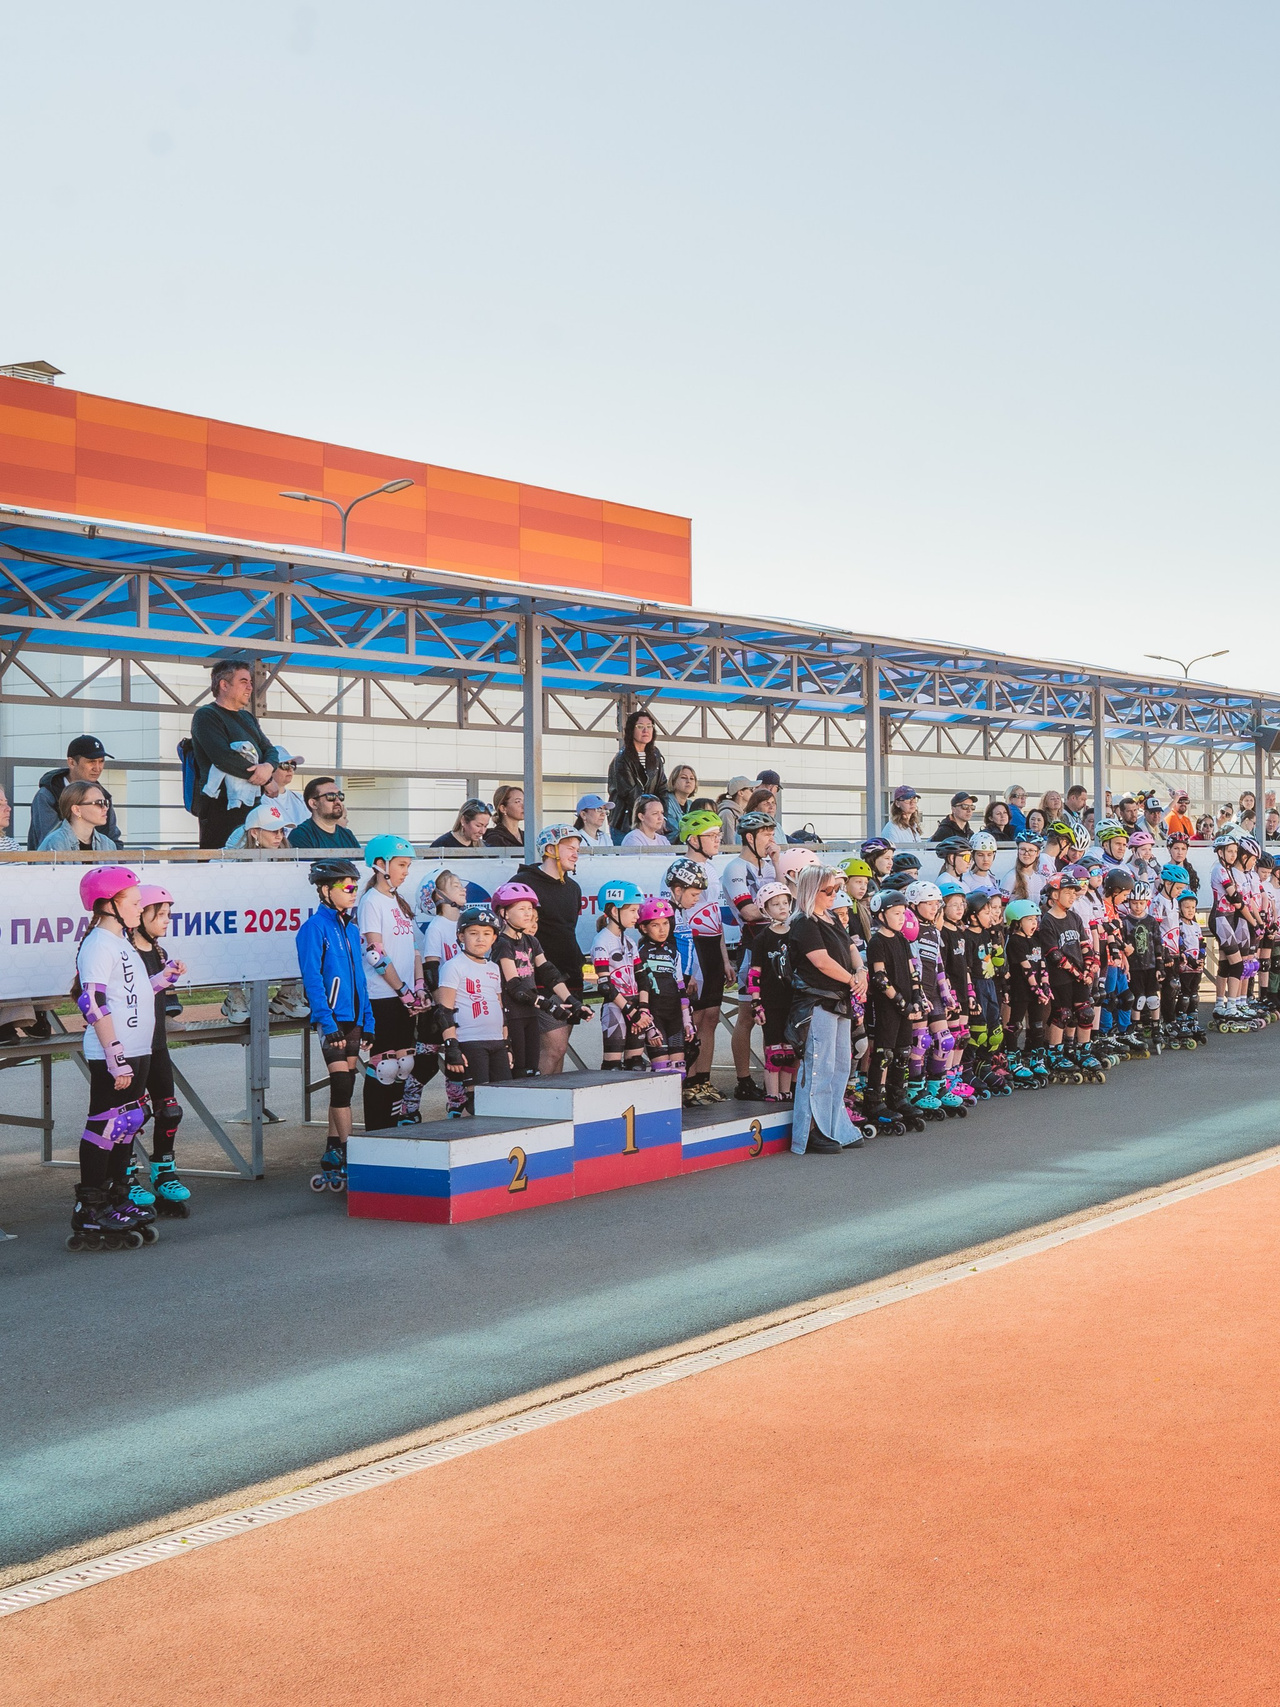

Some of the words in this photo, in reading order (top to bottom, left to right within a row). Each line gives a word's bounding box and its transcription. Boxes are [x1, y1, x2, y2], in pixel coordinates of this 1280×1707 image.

[607, 889, 623, 898] 141
[678, 869, 693, 881] 394
[11, 910, 238, 945] ПАРАТИКЕ
[244, 908, 301, 933] 2025
[621, 1104, 639, 1155] 1
[748, 1119, 763, 1157] 3
[507, 1146, 528, 1194] 2
